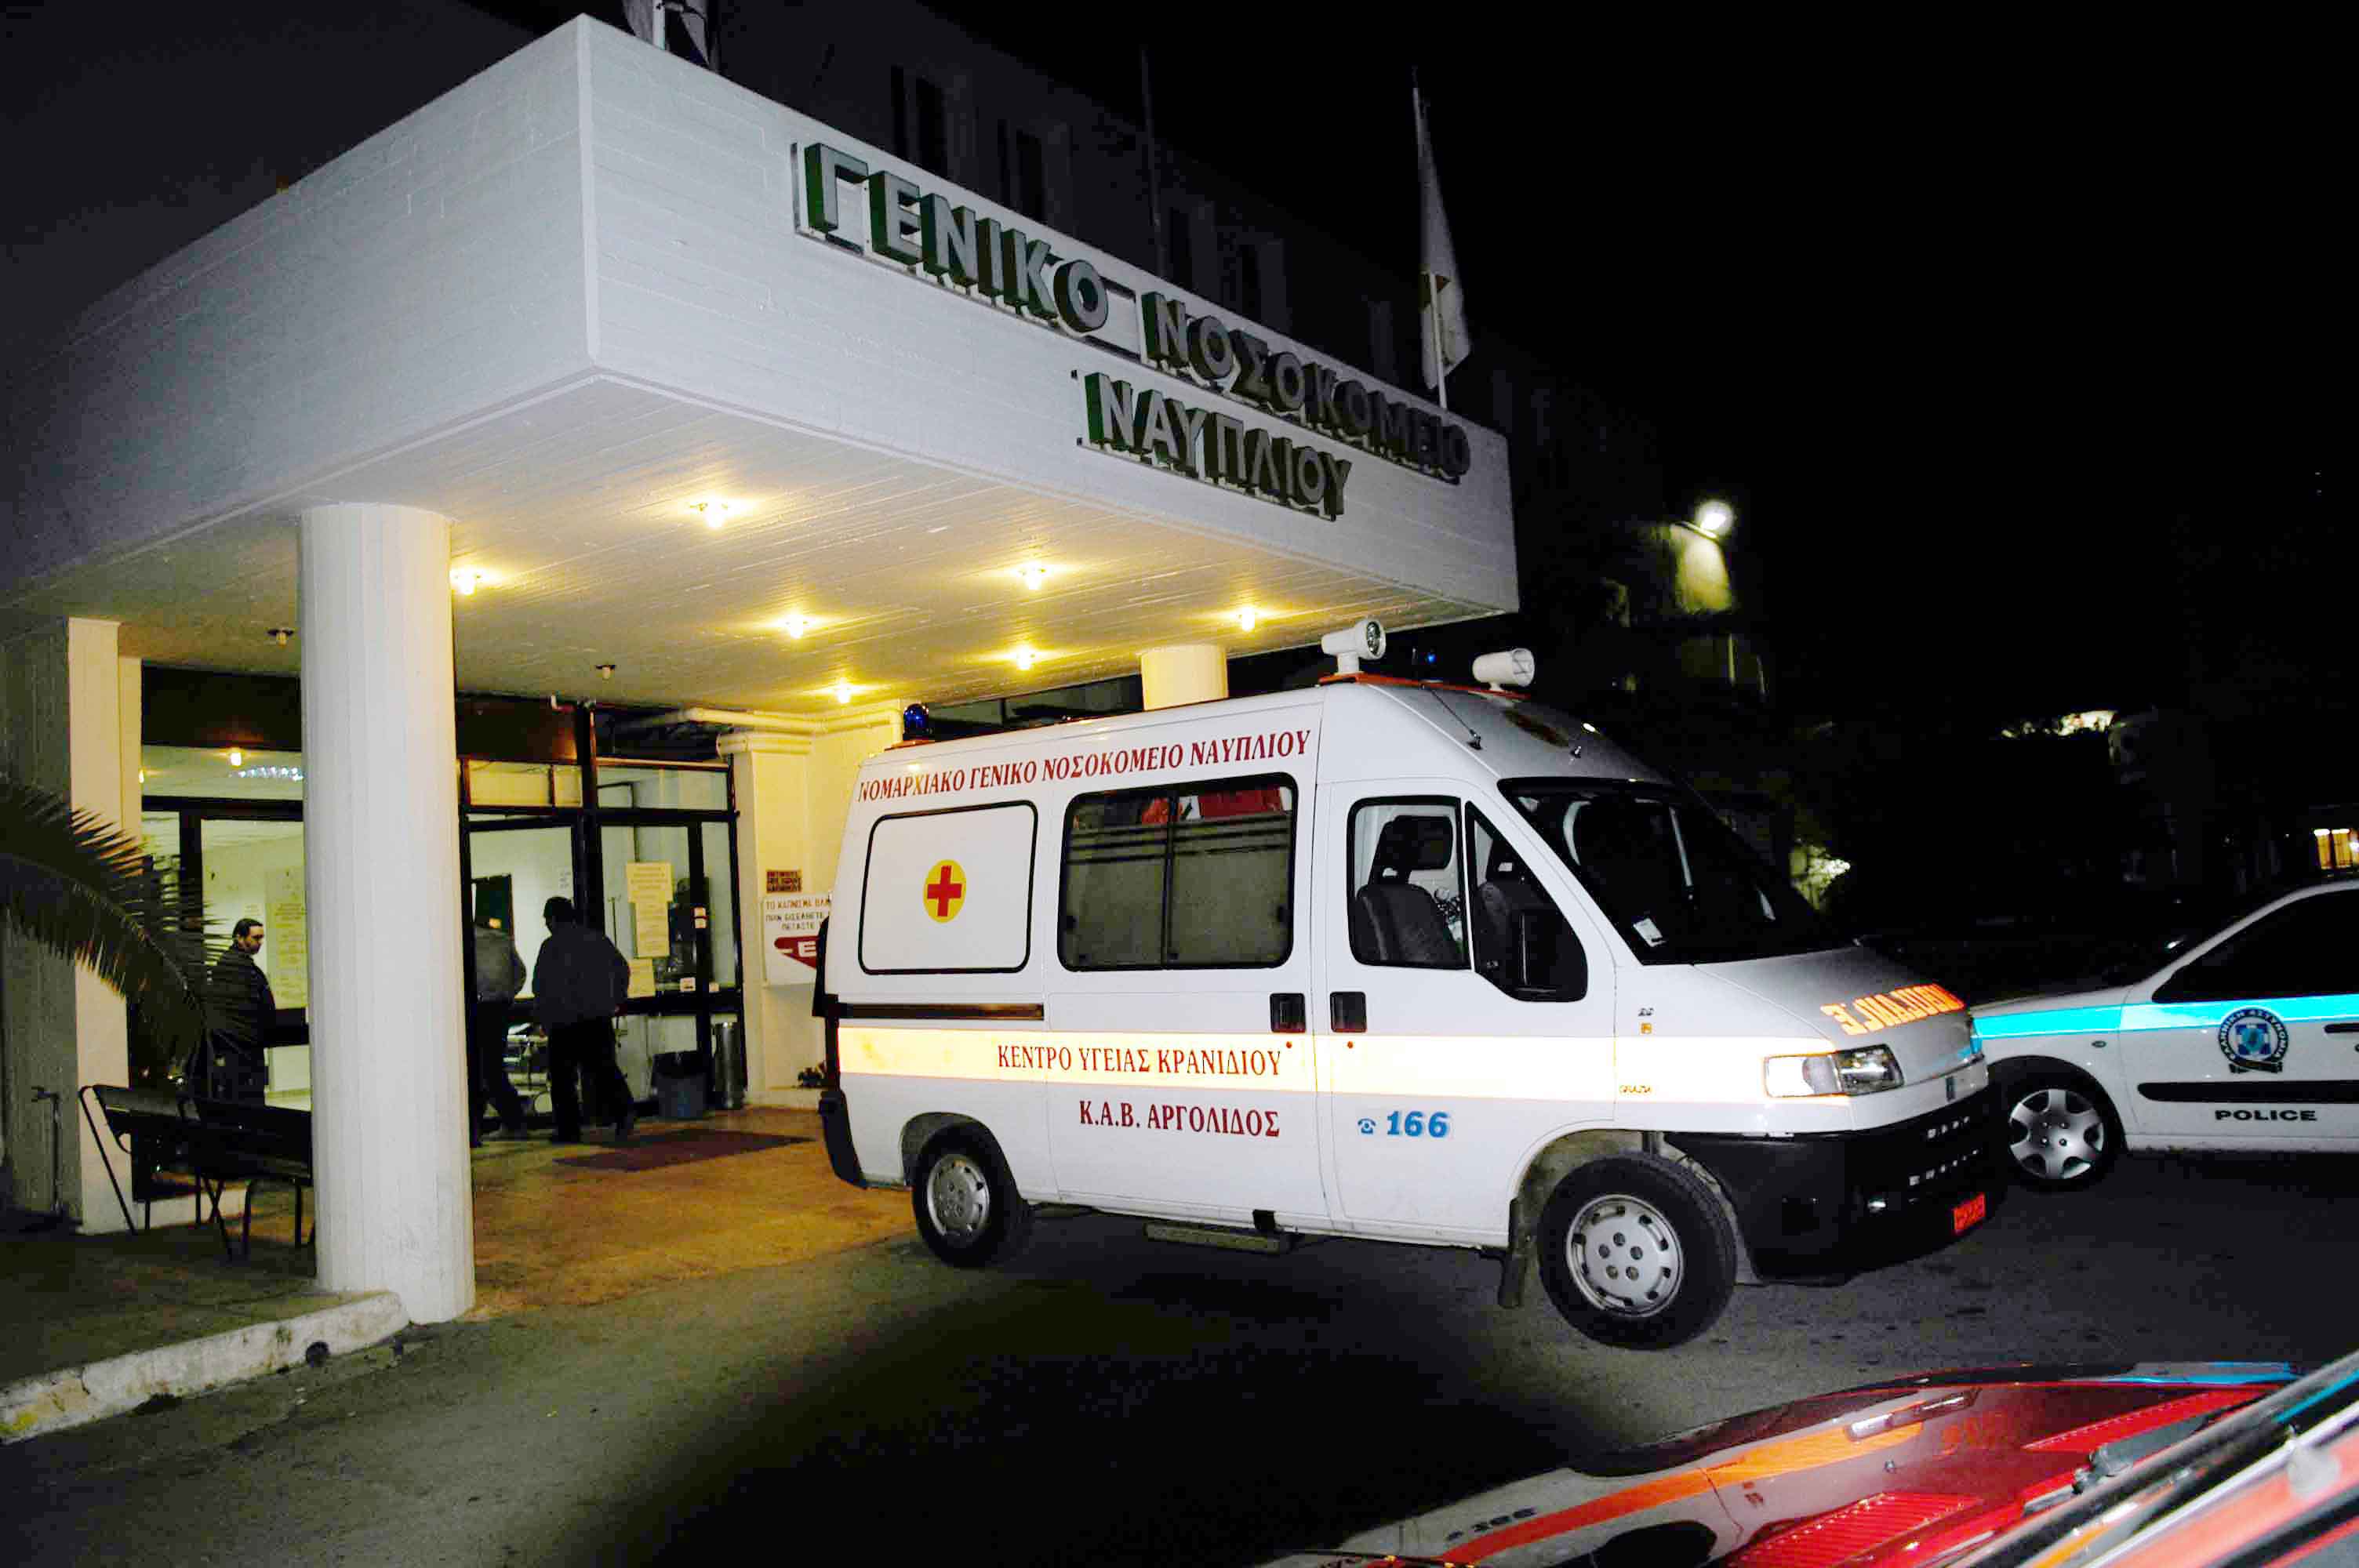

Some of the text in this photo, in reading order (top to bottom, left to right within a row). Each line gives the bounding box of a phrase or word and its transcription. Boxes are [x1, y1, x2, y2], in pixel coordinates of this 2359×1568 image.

[805, 143, 1471, 477] ΓΕΝΙΚΟ ΝΟΣΟΚΟΜΕΙΟ
[1085, 372, 1352, 520] ΝΑΥΠΛΙΟΥ
[858, 729, 1312, 803] ΝΟΜΑΡΧΙΑΚΟ ΓΕΝΙΚΟ ΝΟΣΟΚΟΜΕΙΟ ΝΑΥΠΛΙΟΥ
[997, 1044, 1282, 1077] ΚΕΝΤΡΟ ΥΓΕΙΑΣ ΚΡΑΝΙΔΙΟΥ
[1078, 1100, 1280, 1138] Κ.Α.Β. ΑΡΓΟΛΙΔΟΣ
[1386, 1109, 1451, 1138] 166
[2215, 1109, 2318, 1122] POLICE
